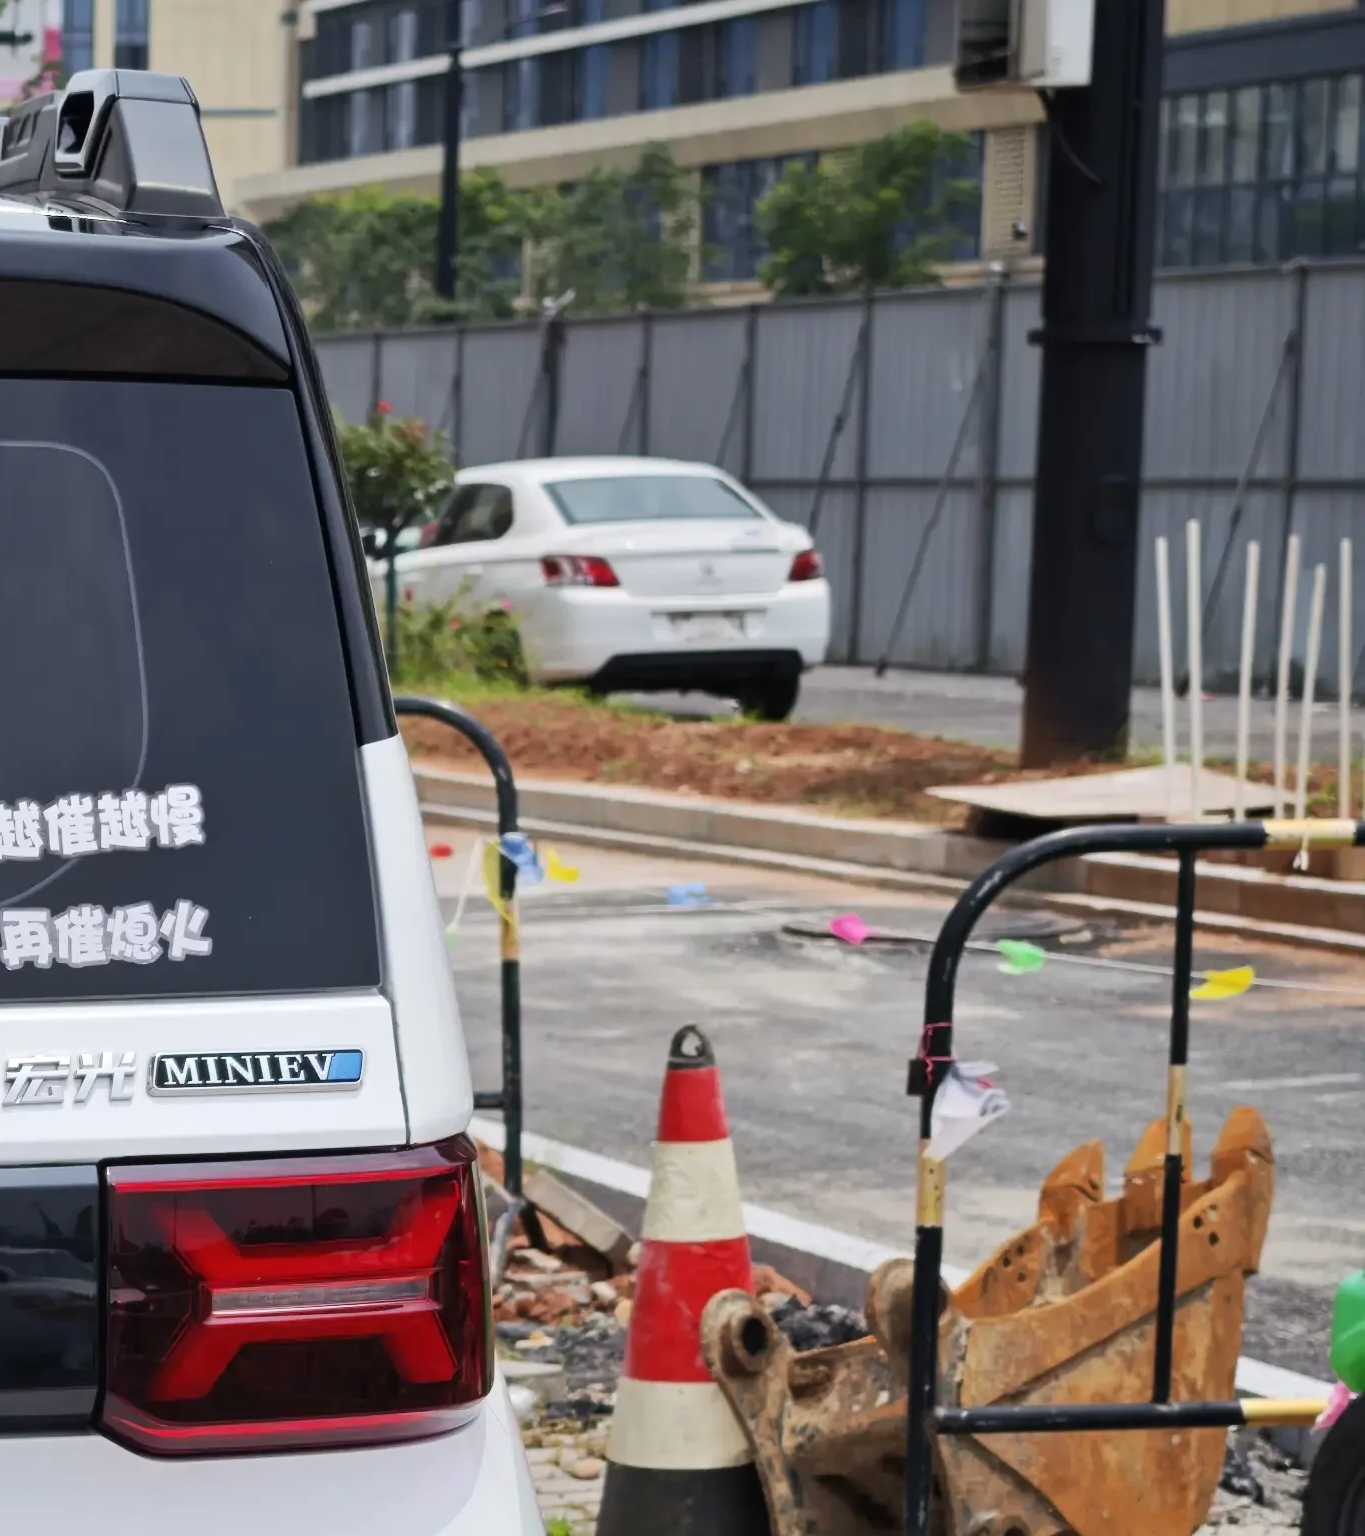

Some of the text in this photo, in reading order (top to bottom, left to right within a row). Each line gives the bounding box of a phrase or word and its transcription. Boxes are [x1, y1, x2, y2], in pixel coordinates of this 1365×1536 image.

[0, 900, 212, 970] 再催熄火
[2, 1051, 335, 1106] 宏光 MINIEV
